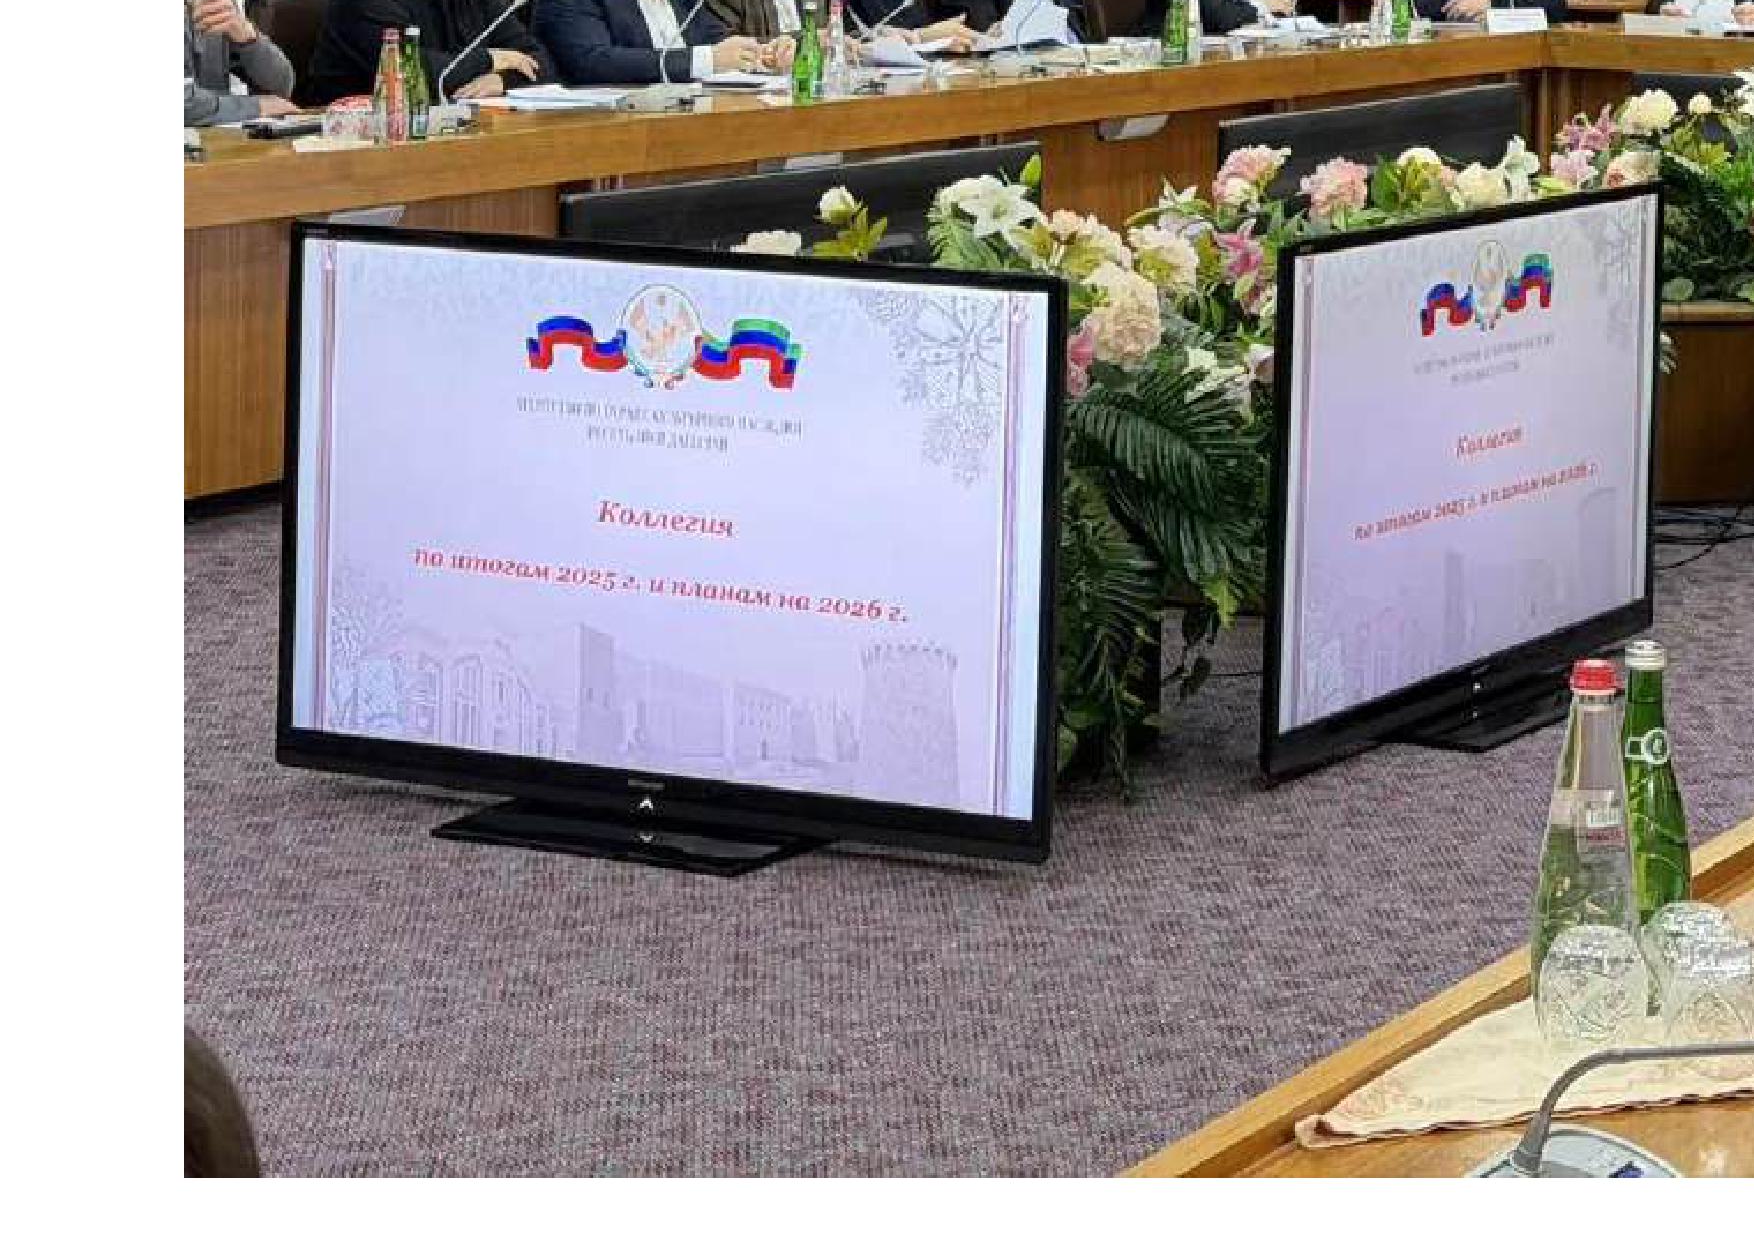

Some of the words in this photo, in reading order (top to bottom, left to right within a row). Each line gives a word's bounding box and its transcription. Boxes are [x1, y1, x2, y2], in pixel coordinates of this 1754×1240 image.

[598, 500, 735, 537] Коллегия
[415, 548, 444, 568] по
[451, 553, 549, 583] итогам
[555, 563, 616, 592] 2025
[649, 578, 665, 594] и
[670, 580, 772, 607] планам
[779, 591, 811, 612] на
[816, 596, 882, 621] 2026
[888, 605, 909, 623] г.
